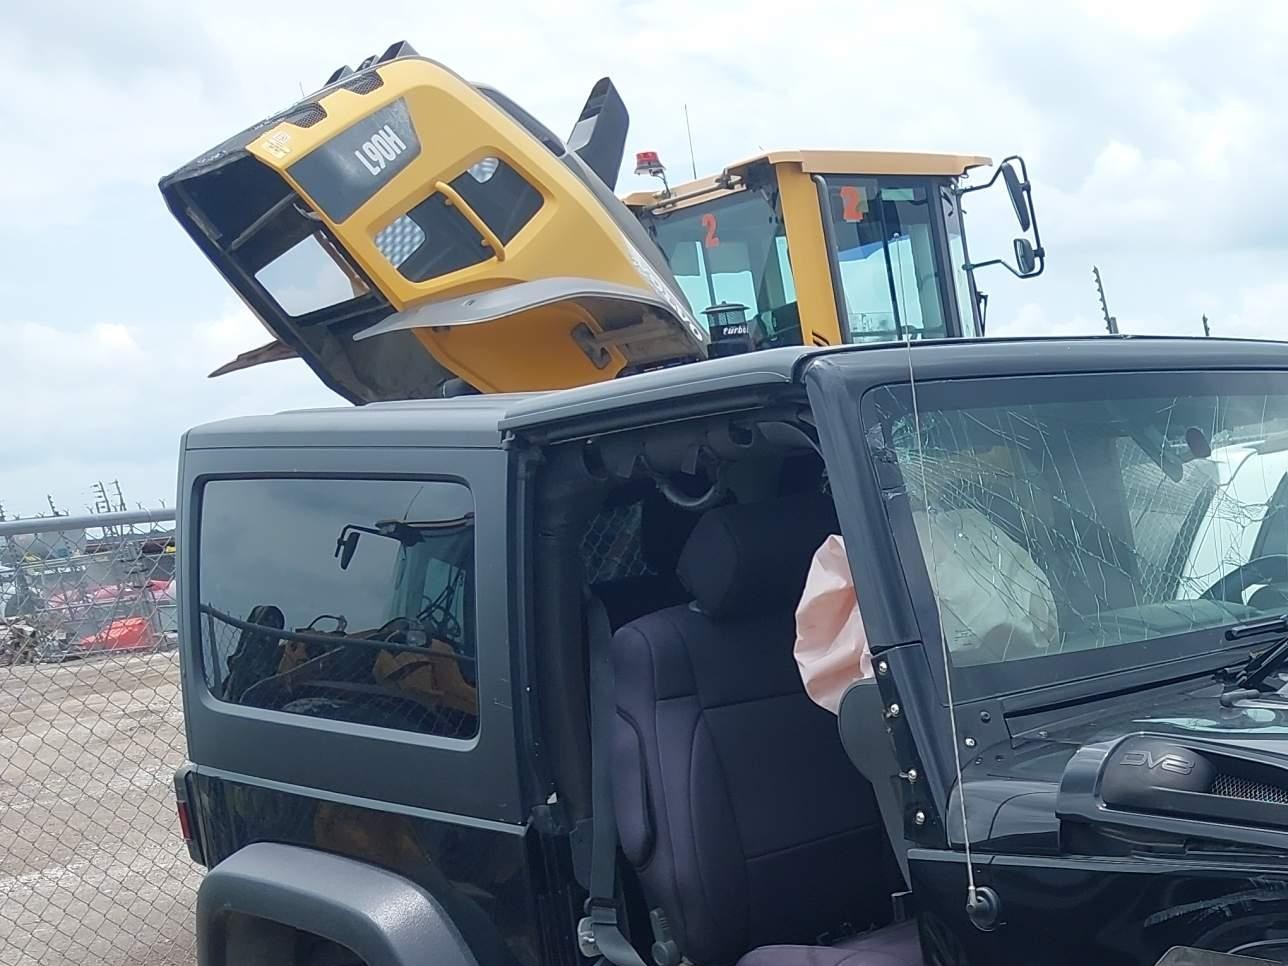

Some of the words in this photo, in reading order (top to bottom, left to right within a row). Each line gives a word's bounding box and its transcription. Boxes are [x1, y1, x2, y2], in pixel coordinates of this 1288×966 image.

[354, 124, 407, 176] L90H
[840, 185, 864, 221] 2
[702, 213, 720, 249] 2
